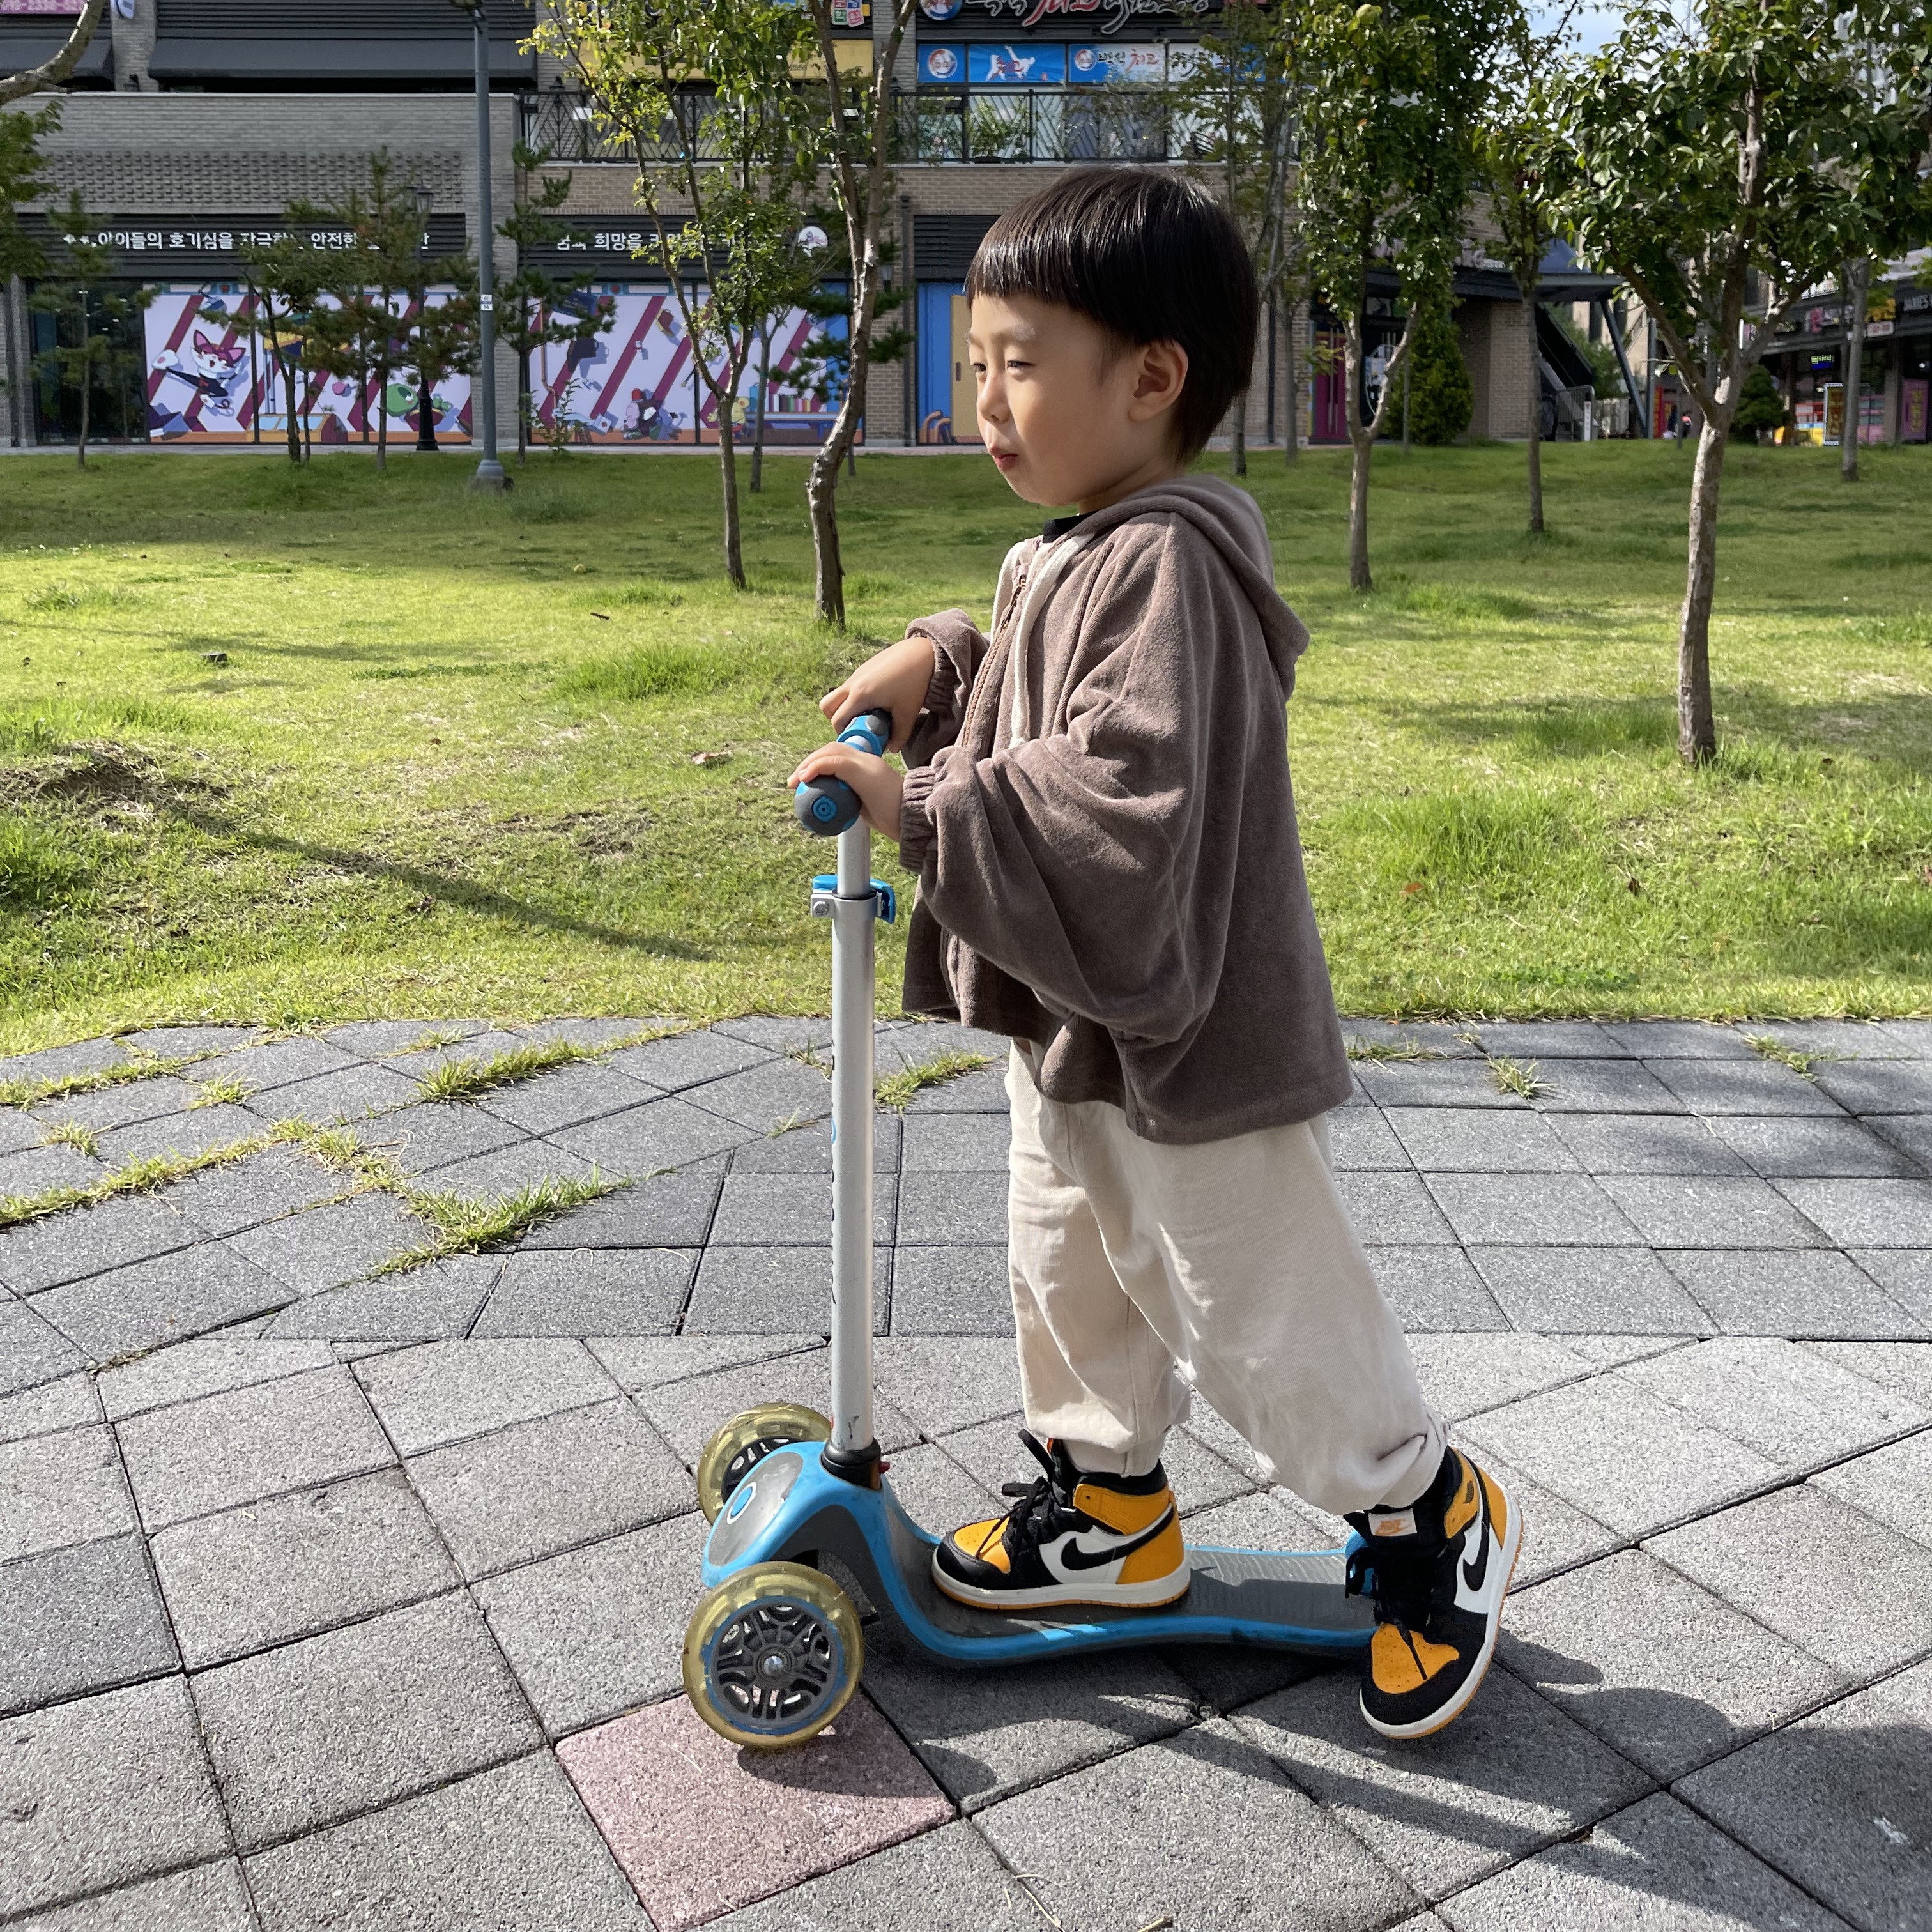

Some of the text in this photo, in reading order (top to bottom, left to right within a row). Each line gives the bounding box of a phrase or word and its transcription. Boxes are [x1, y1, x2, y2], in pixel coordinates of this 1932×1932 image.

[98, 232, 163, 250] 아이들의
[169, 232, 234, 250] 호기심을
[594, 233, 643, 251] 희망을
